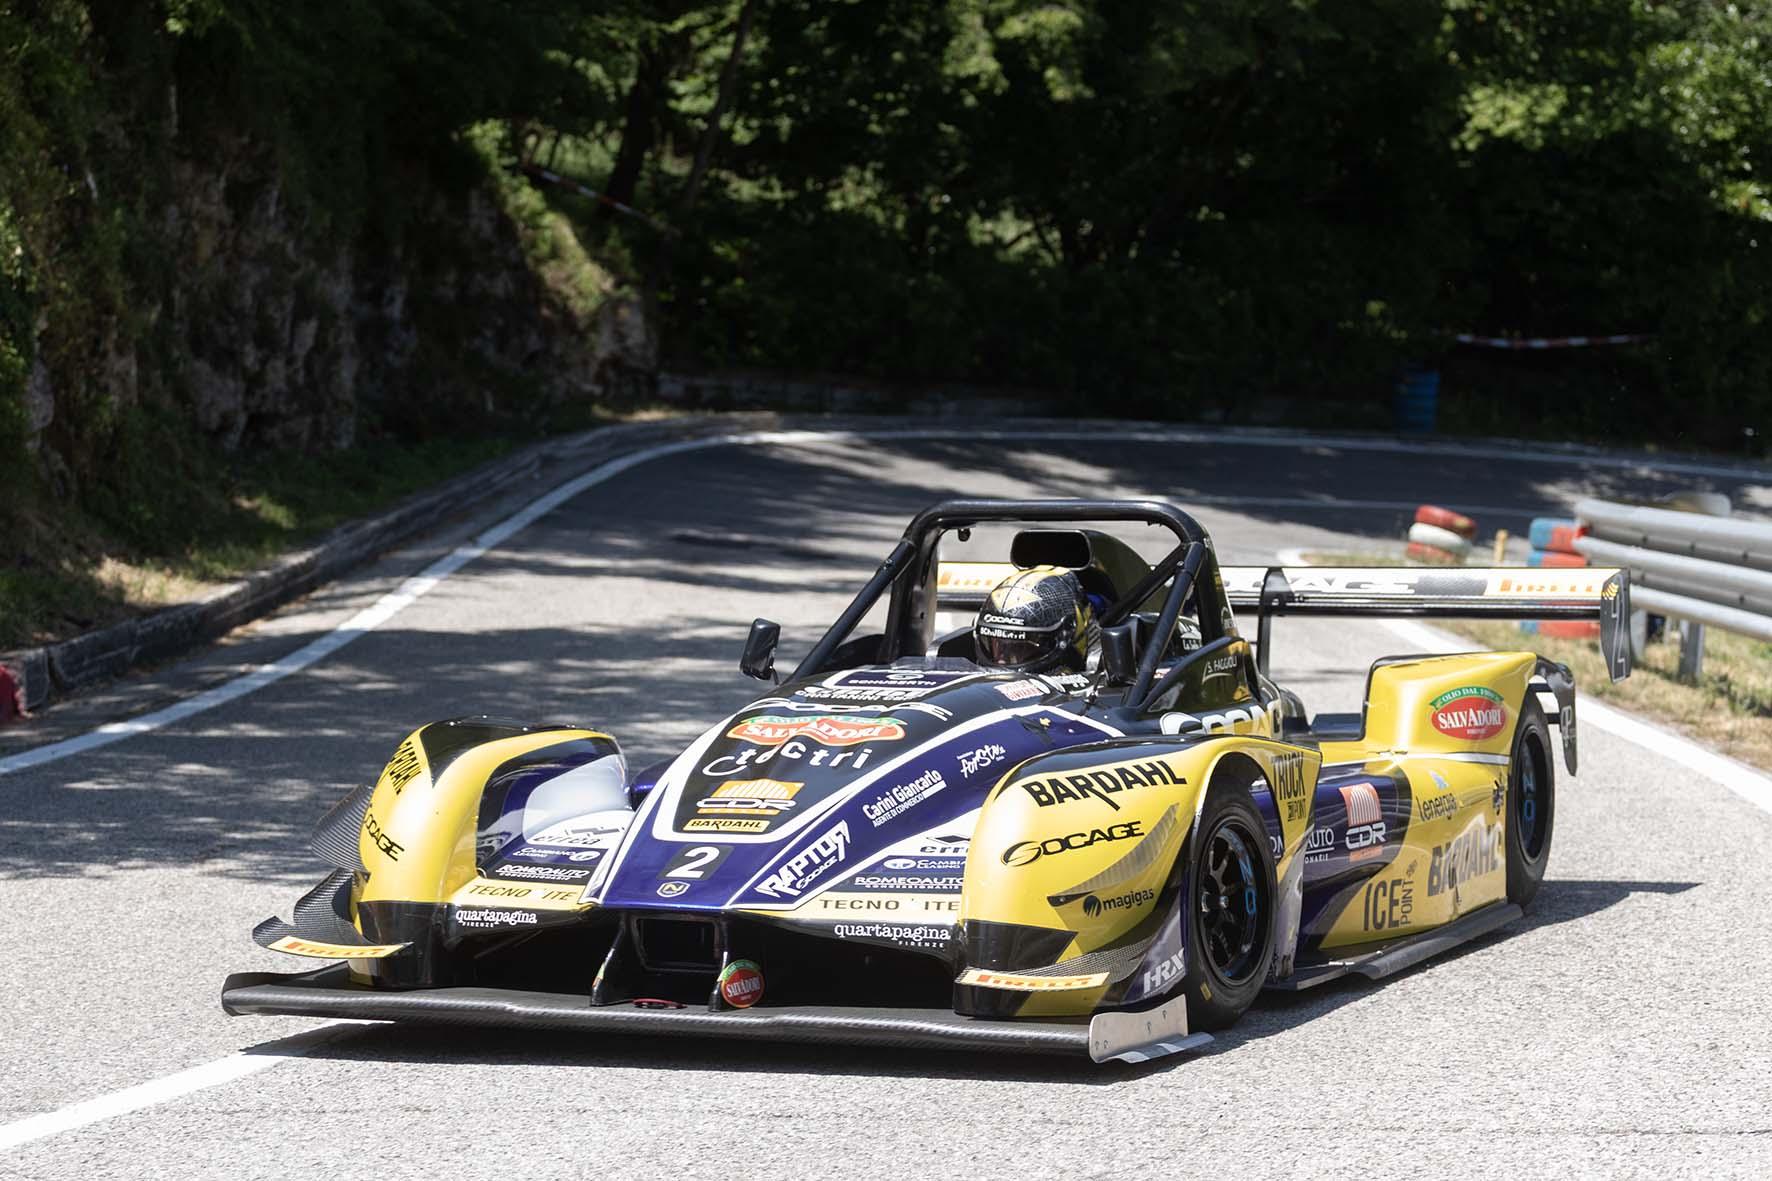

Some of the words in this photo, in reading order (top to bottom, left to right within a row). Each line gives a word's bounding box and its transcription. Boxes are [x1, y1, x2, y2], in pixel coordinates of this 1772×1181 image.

[1437, 707, 1502, 729] SALVADORI
[862, 791, 898, 820] Carini
[892, 769, 942, 803] Giancarlo
[1022, 760, 1187, 811] BARDAHL
[690, 819, 763, 830] BARDAHL
[872, 811, 893, 828] AGENTE
[1346, 821, 1387, 850] CDR
[665, 845, 720, 879] 2
[468, 884, 532, 898] TECNO
[1102, 889, 1155, 911] magigas
[819, 899, 900, 911] TECNO
[1363, 878, 1402, 932] ICE
[1400, 880, 1415, 925] POINT
[455, 908, 538, 926] quartapagina
[833, 923, 951, 941] quartapagina
[898, 940, 945, 948] FIRENZE
